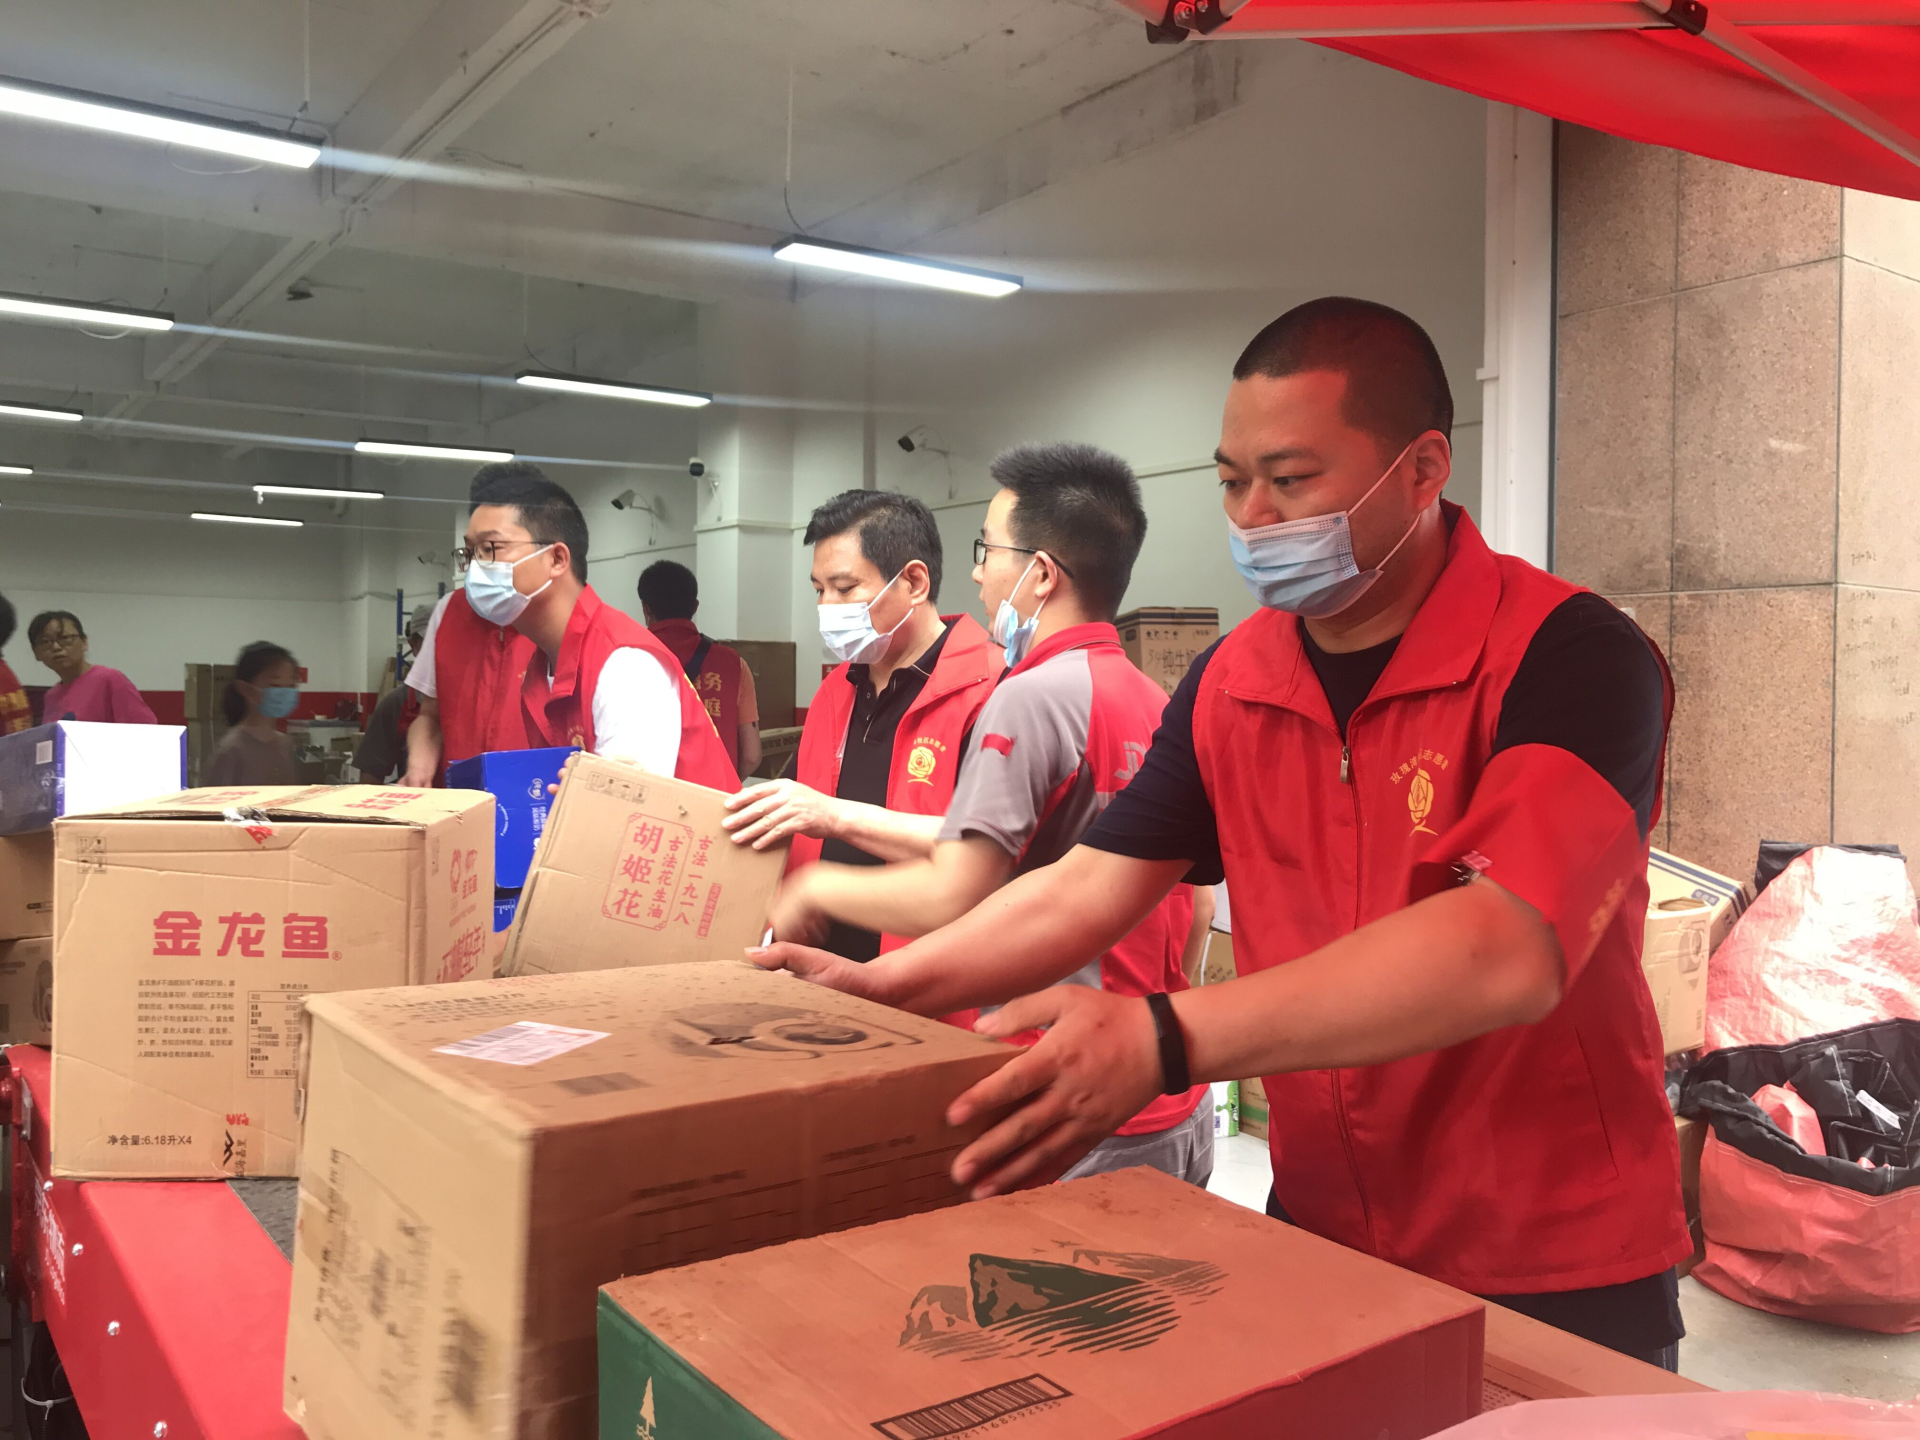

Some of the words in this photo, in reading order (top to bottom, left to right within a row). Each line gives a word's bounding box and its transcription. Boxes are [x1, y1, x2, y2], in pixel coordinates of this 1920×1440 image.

[611, 821, 665, 919] 胡姬花
[647, 835, 685, 920] 古法花生油
[673, 834, 714, 926] 古法一九一八
